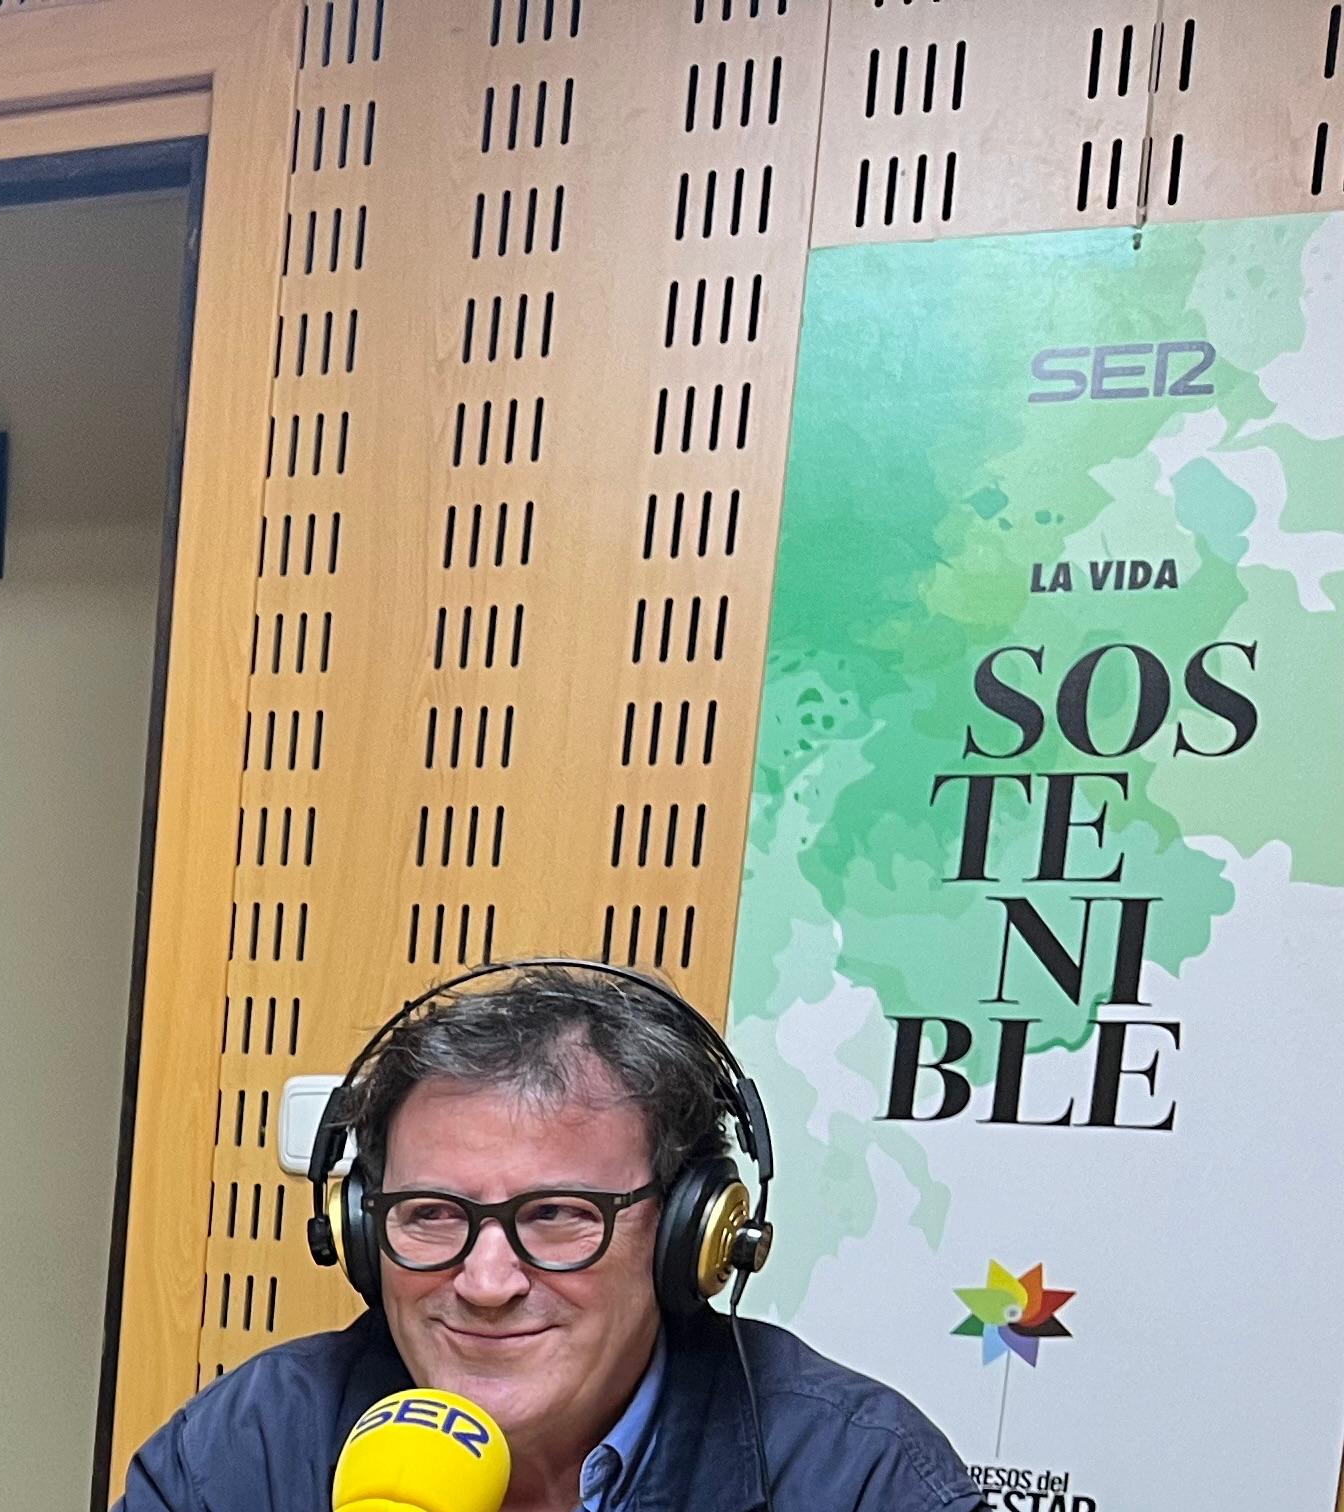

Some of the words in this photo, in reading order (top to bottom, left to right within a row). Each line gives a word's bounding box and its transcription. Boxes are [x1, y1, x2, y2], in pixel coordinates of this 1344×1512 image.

[1027, 340, 1217, 403] SER
[1030, 562, 1073, 593] LA
[1089, 558, 1179, 591] VIDA
[962, 640, 1259, 760] SOS
[929, 771, 1130, 884] TE
[977, 896, 1164, 1007] NI
[874, 1014, 1182, 1132] BLE
[350, 1399, 489, 1458] SER
[965, 1465, 1033, 1490] RESOS
[1037, 1469, 1069, 1494] del
